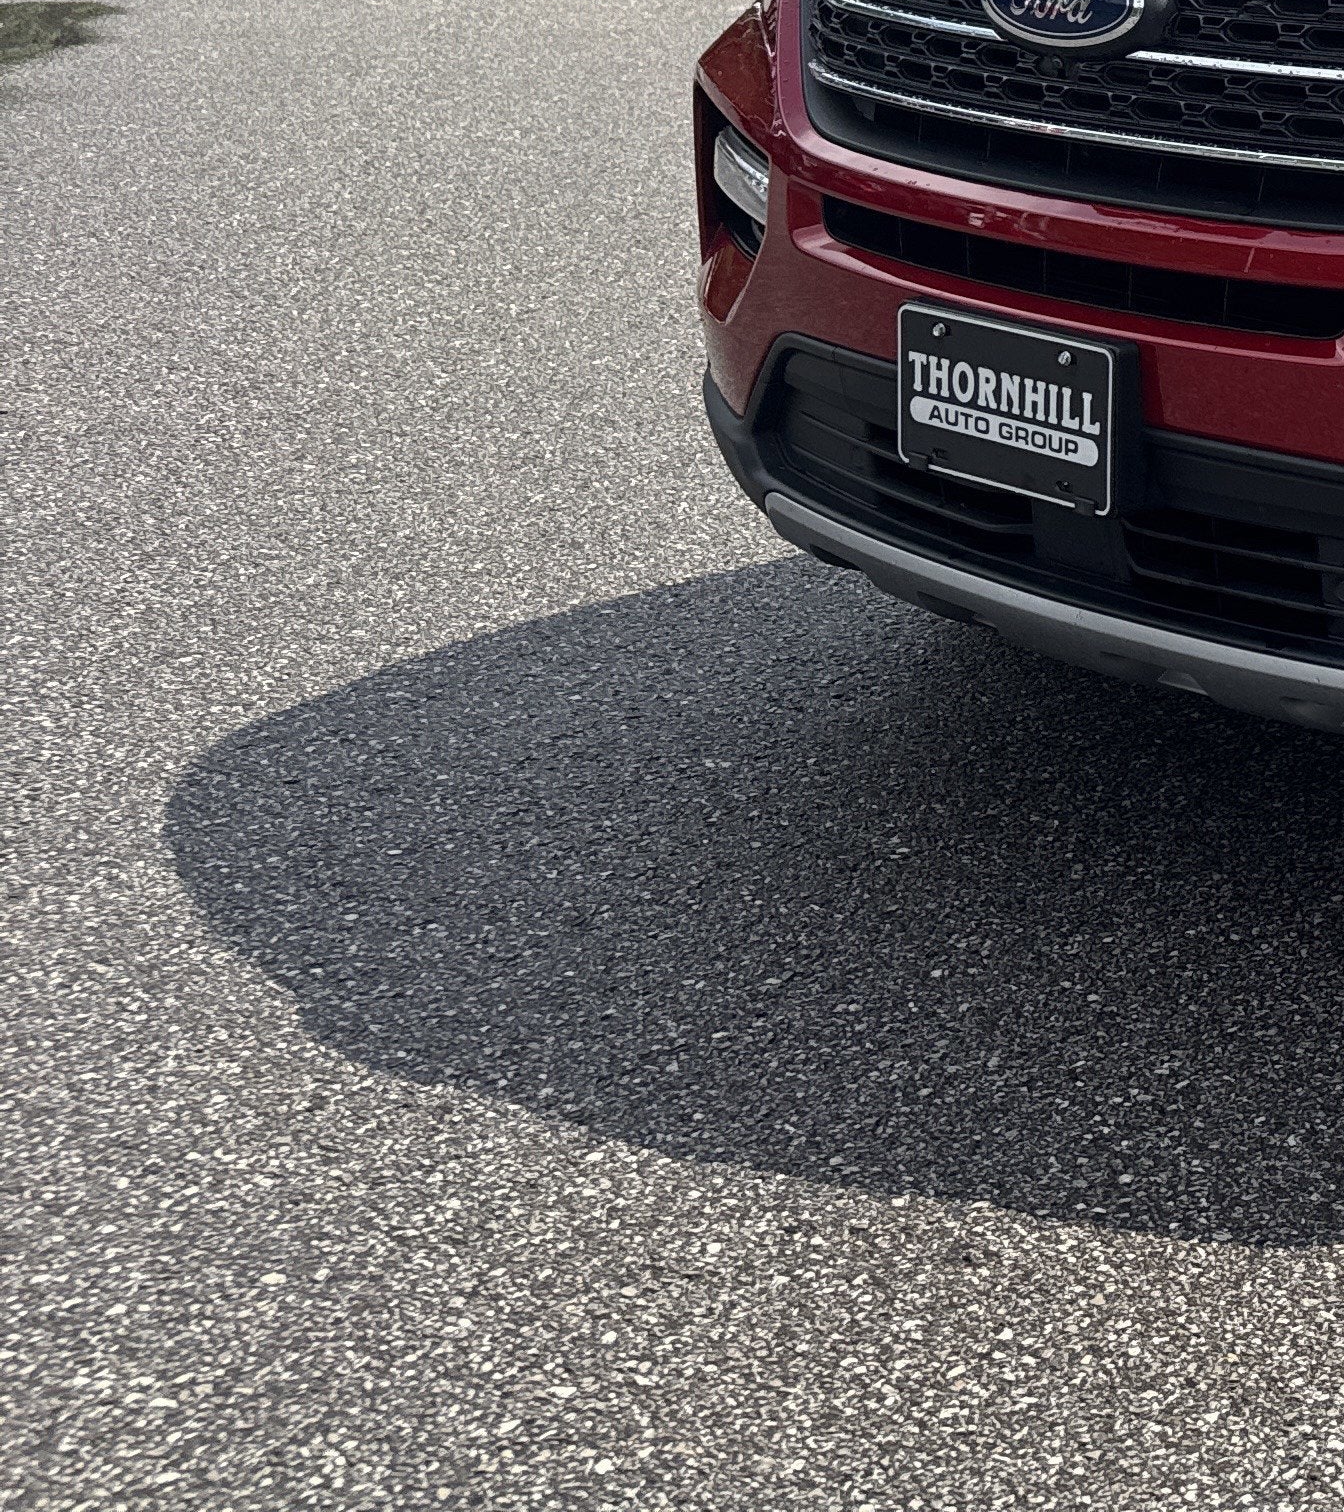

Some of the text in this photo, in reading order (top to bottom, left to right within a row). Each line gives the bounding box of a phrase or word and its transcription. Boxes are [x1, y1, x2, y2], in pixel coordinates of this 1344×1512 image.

[908, 351, 1100, 436] THORNHILL
[928, 405, 1079, 456] AUTO GROUP
